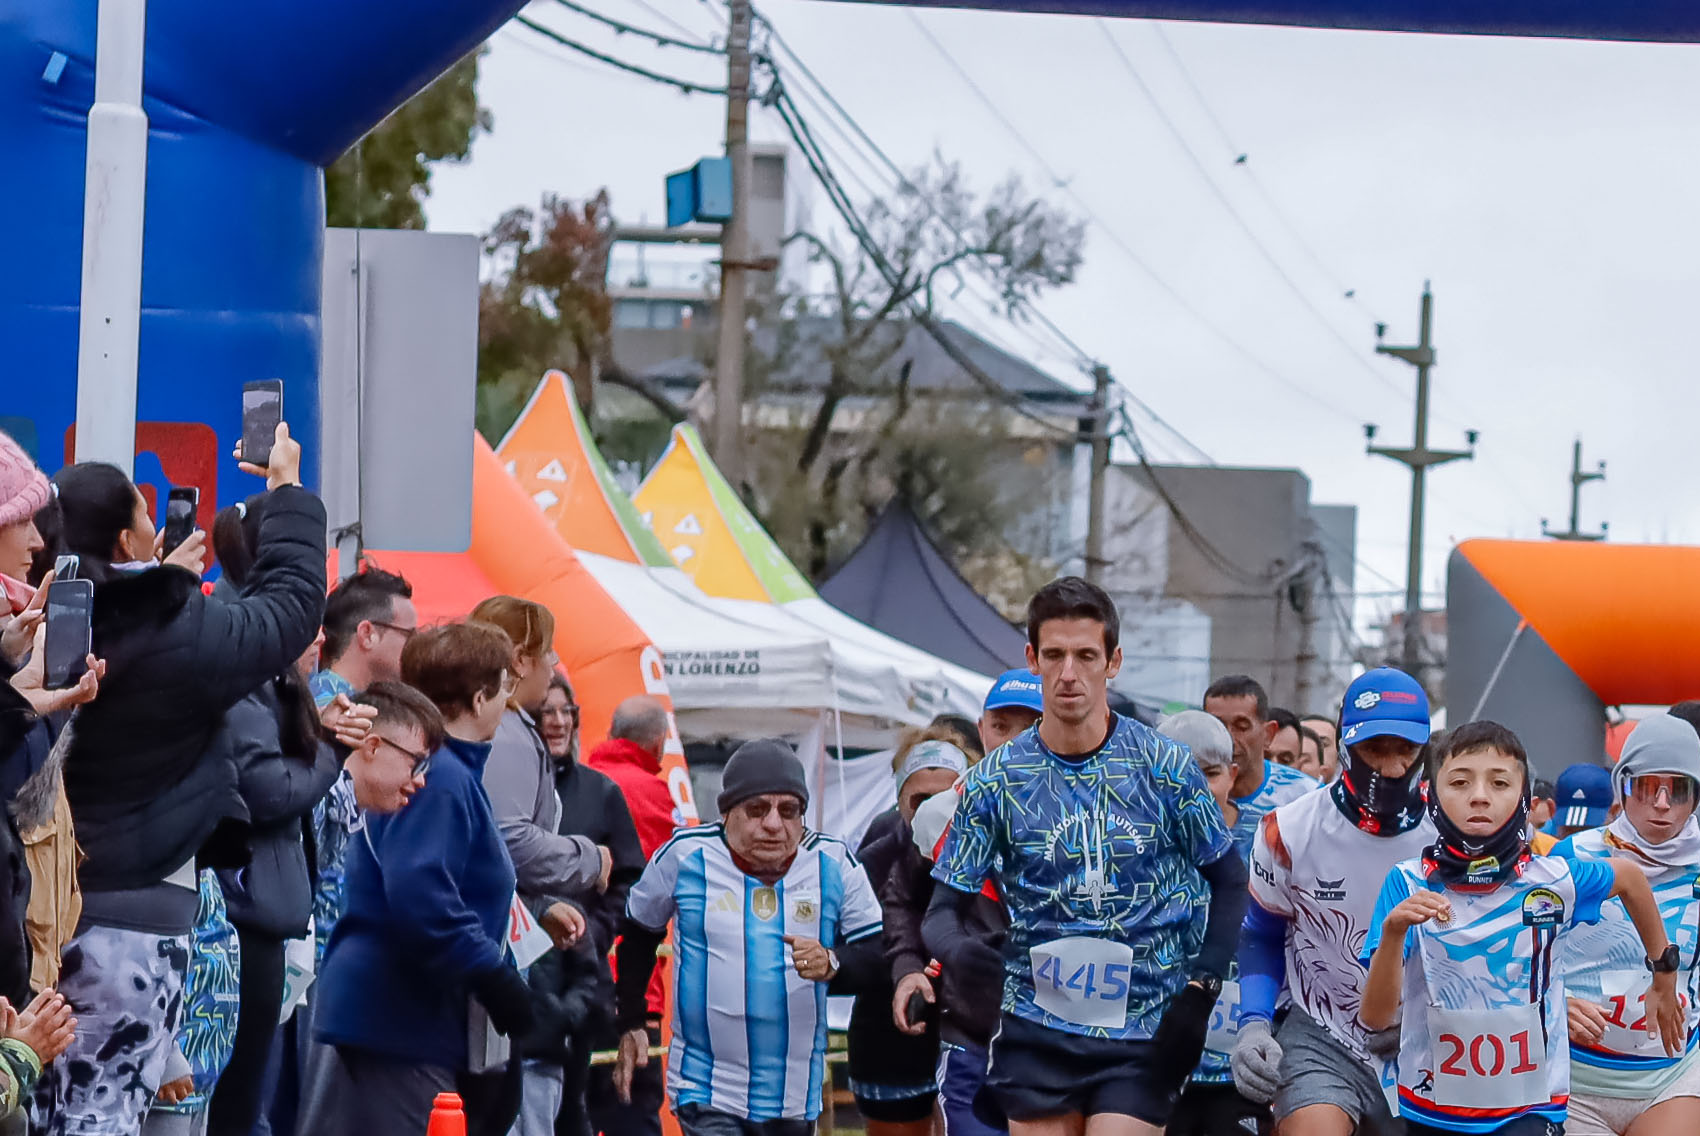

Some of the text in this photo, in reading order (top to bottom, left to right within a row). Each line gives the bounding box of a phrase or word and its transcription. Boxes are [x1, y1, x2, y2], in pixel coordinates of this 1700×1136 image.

[679, 662, 761, 676] LORENZO
[1044, 814, 1080, 861] MARATON
[1109, 813, 1145, 855] AUTISMO
[1037, 957, 1129, 1000] 445
[1439, 1030, 1538, 1077] 201
